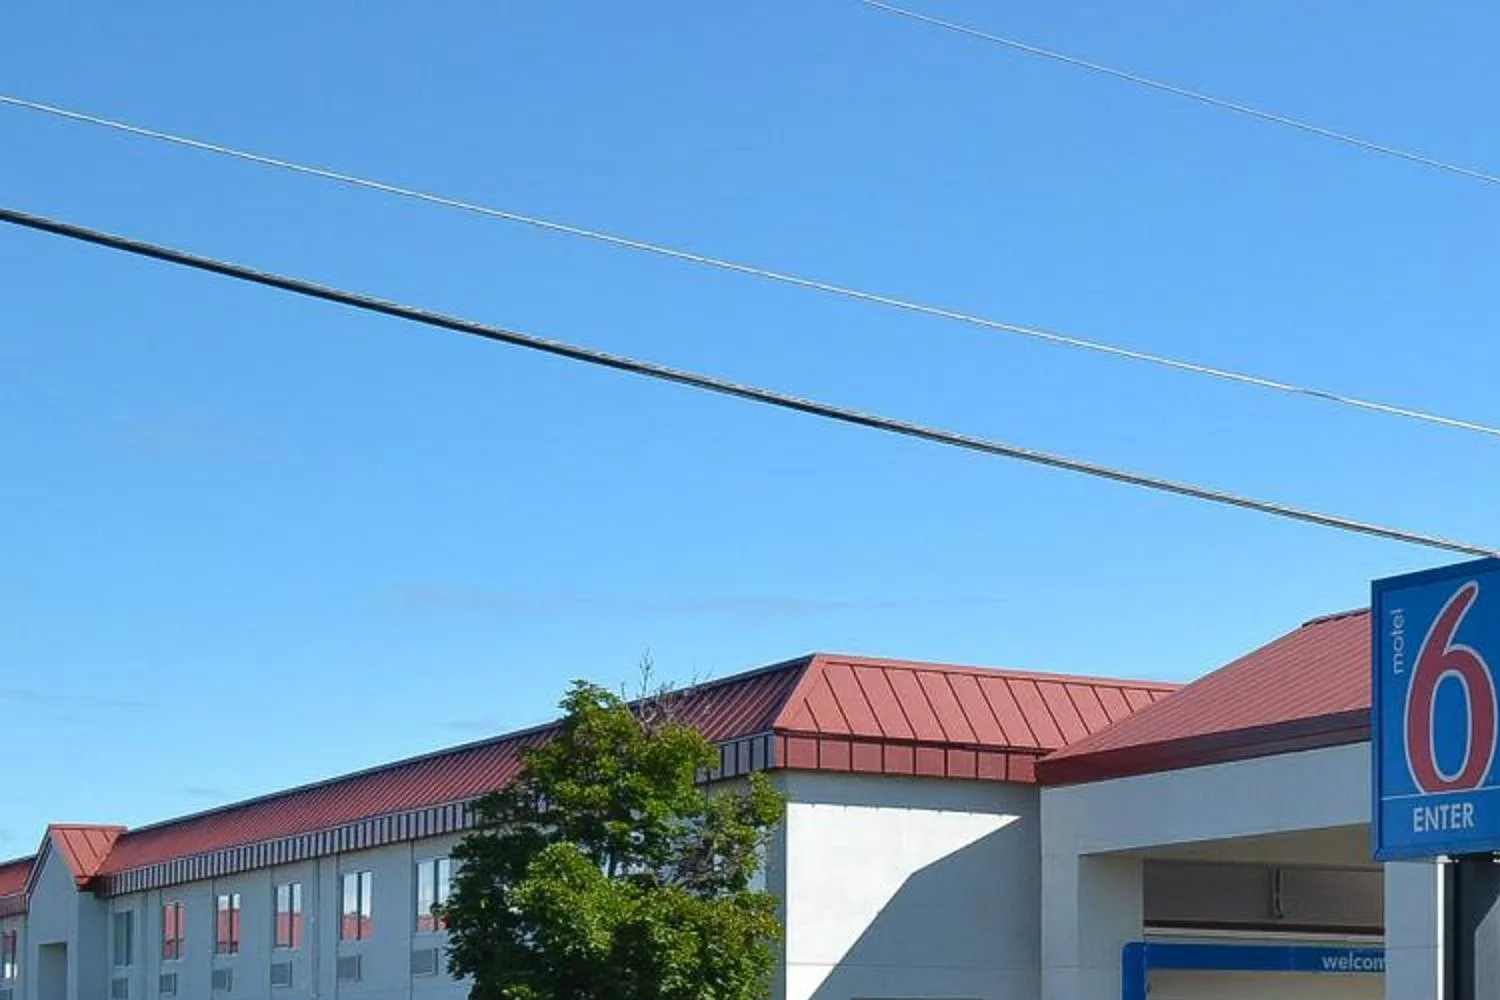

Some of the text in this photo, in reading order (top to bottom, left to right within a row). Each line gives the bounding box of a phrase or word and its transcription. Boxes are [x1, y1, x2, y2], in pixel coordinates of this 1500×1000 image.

[1391, 579, 1499, 796] motel 6
[1413, 802, 1474, 832] ENTER
[1321, 950, 1386, 970] welcom
